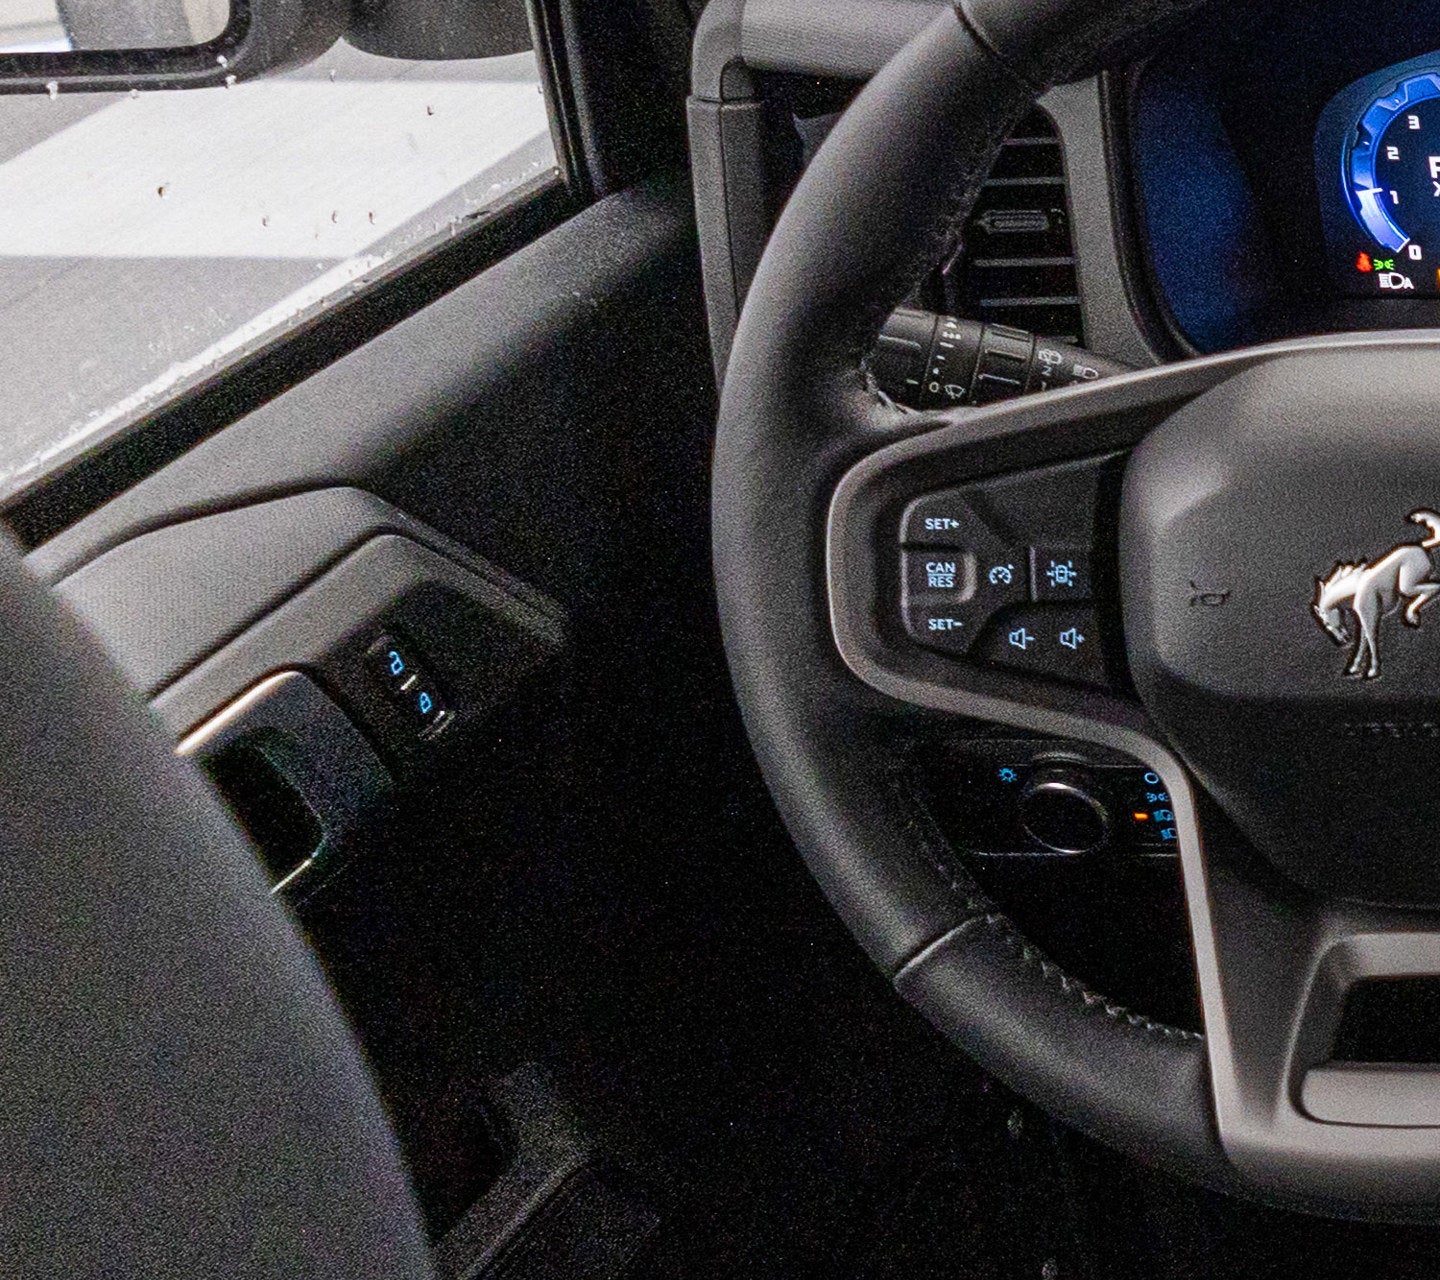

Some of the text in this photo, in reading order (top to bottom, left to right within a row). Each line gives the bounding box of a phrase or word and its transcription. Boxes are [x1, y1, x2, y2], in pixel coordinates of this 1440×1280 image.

[1408, 115, 1420, 130] 3
[1387, 146, 1399, 160] 2
[1408, 244, 1422, 260] 0
[925, 517, 960, 530] SET+
[925, 562, 956, 574] CAN
[929, 576, 954, 589] RES
